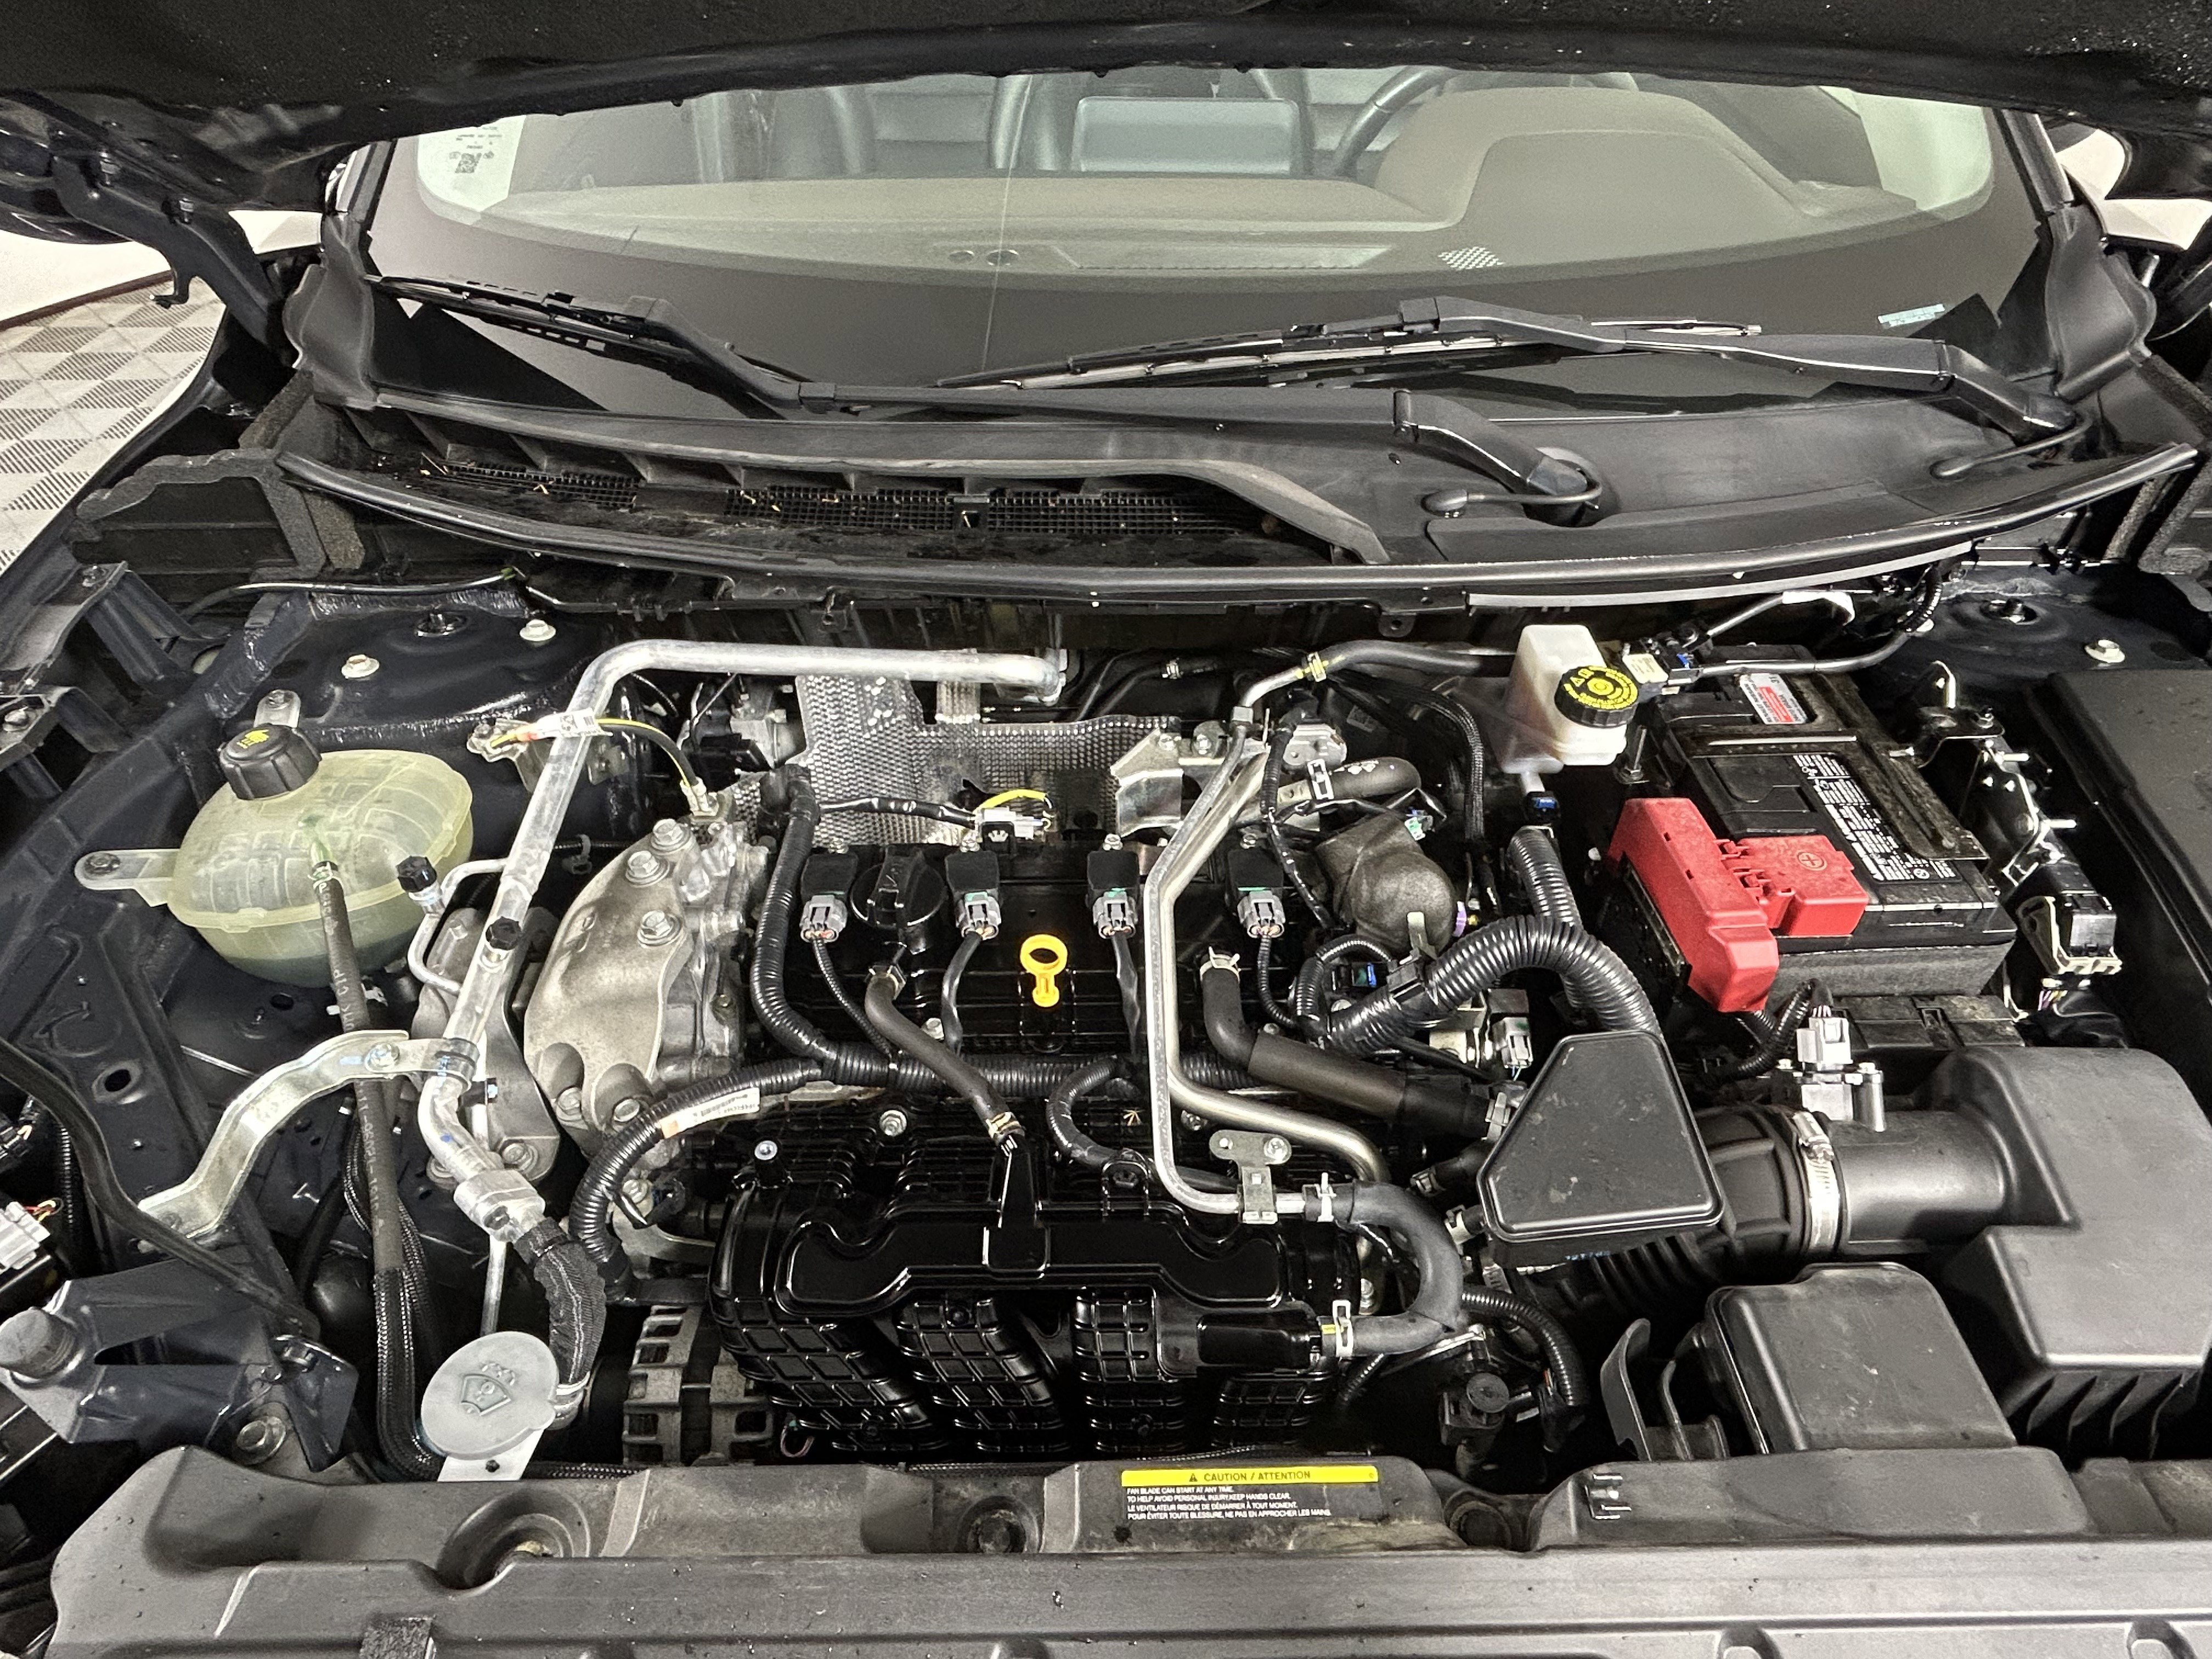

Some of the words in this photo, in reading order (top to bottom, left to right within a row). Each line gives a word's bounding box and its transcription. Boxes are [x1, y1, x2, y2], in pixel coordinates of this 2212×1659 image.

[1204, 1472, 1247, 1481] CAUTION
[1258, 1471, 1311, 1480] ATTENTION
[1147, 1511, 1168, 1520] ÉVITER
